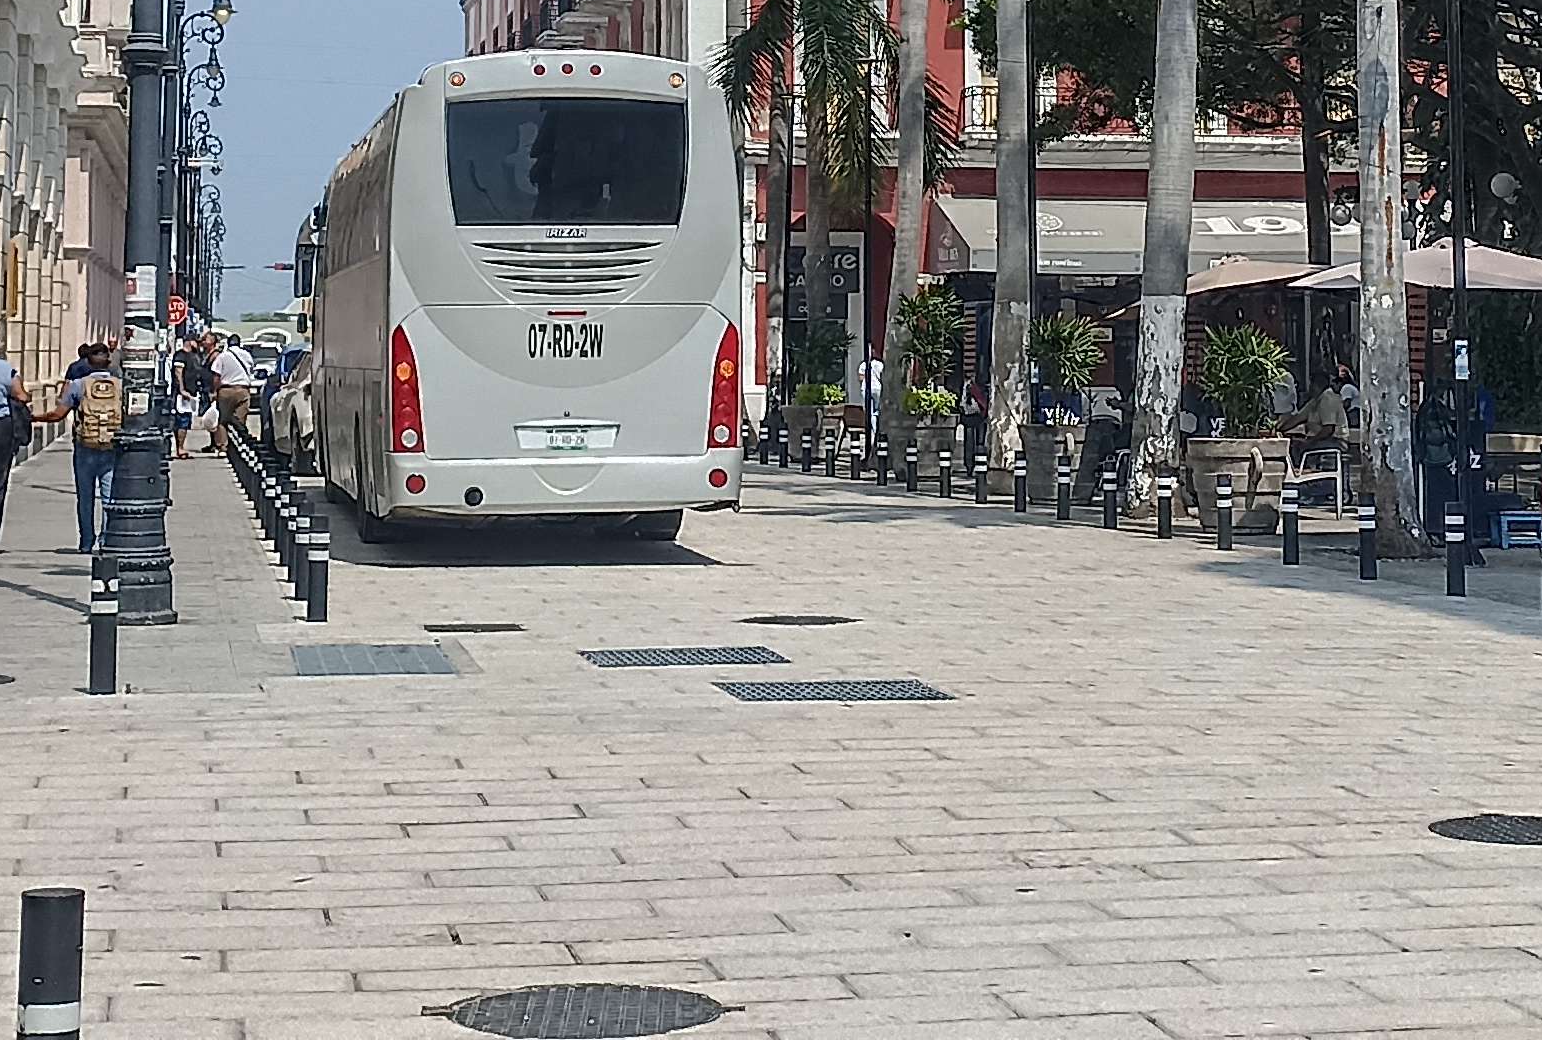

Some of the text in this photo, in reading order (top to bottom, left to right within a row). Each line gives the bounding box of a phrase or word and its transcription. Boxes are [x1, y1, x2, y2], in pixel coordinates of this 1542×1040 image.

[546, 228, 587, 238] IRIZAR
[168, 301, 185, 311] LTO
[528, 323, 604, 359] 07-RD-2W
